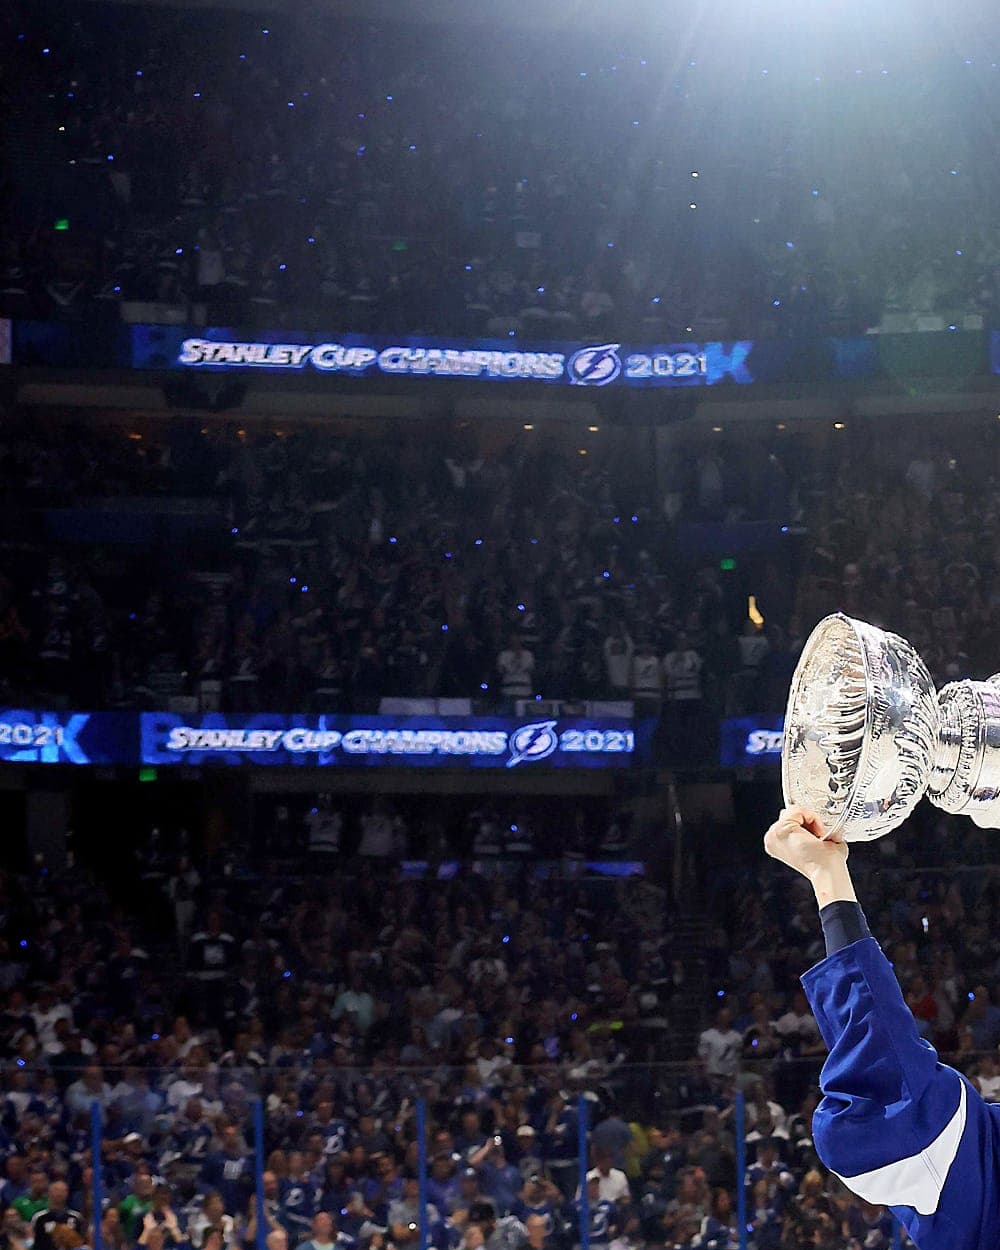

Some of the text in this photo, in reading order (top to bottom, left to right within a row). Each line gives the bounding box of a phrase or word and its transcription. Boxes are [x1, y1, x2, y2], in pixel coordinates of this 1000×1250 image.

[180, 338, 707, 379] STANLEY CUP CHAMPIONS 2021
[0, 722, 64, 747] 2021
[166, 727, 635, 755] STANLEY CUP CHAMPIONS 2021
